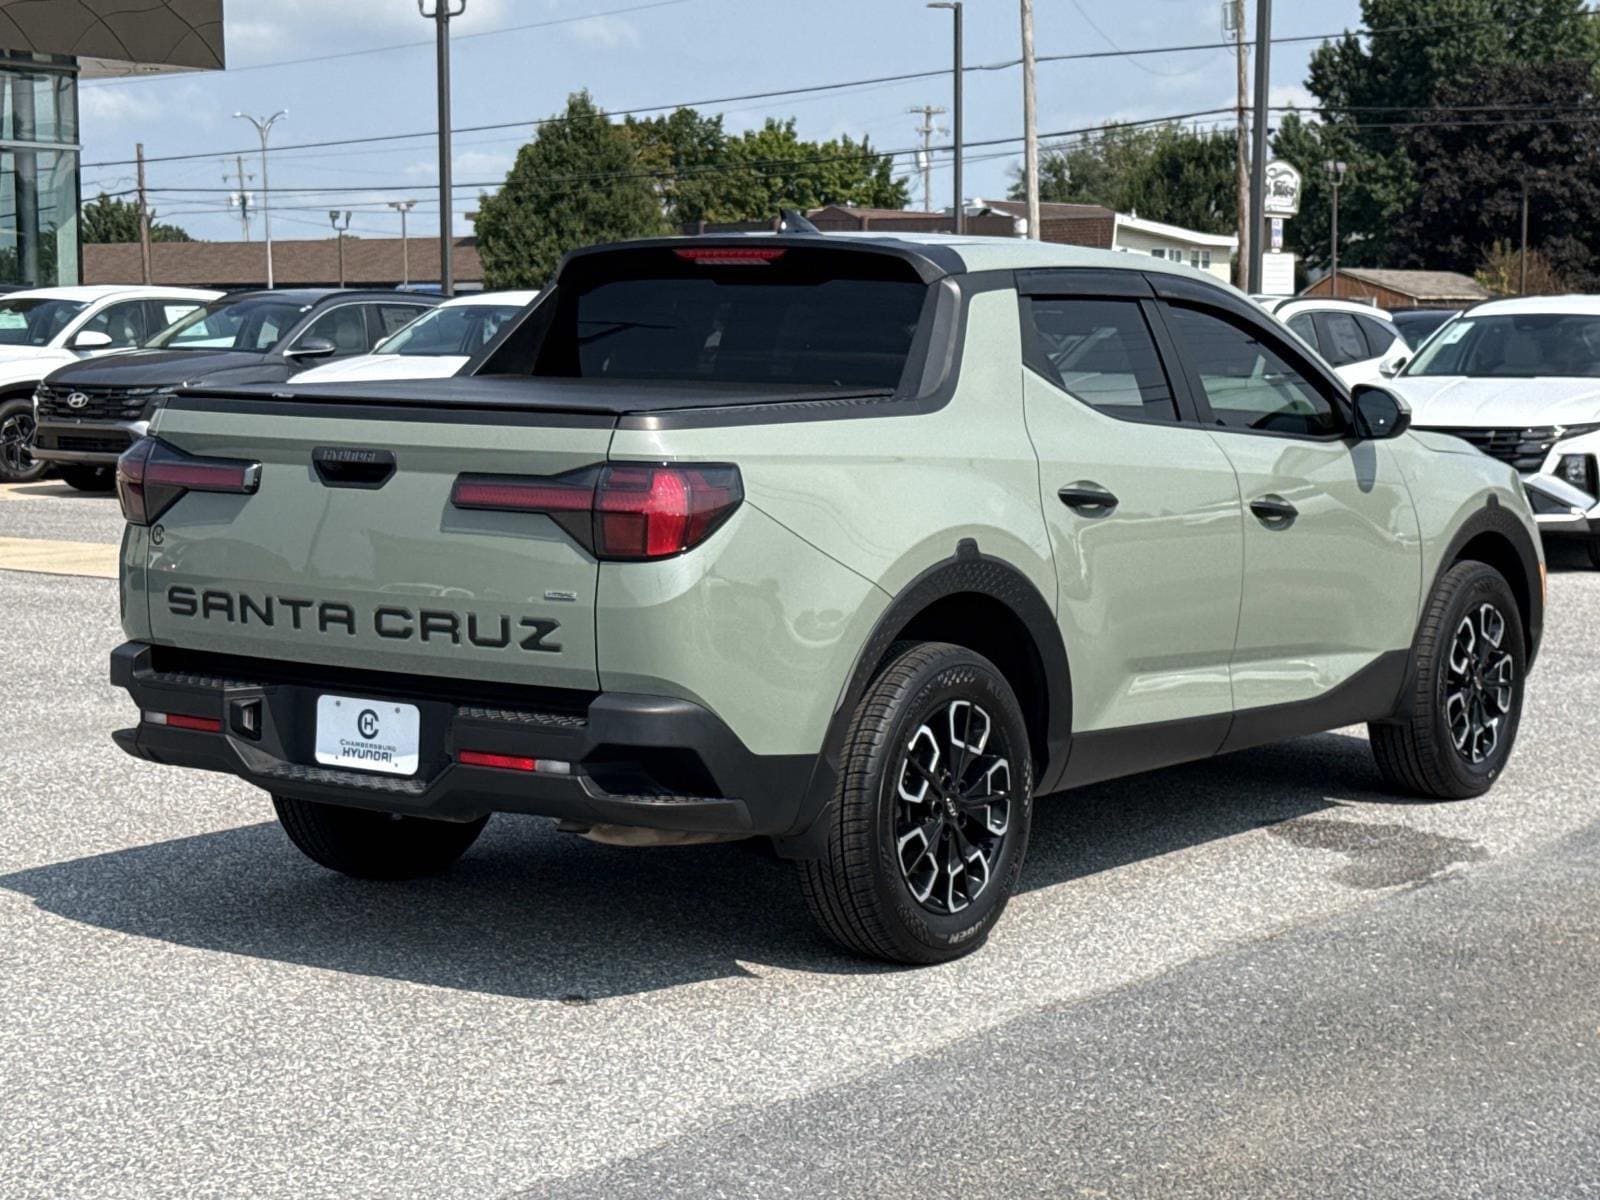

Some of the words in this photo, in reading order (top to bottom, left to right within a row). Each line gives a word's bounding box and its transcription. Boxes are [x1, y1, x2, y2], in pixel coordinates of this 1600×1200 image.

[168, 586, 356, 635] SANTA
[374, 605, 563, 653] CRUZ
[342, 747, 393, 763] HYUNDAI
